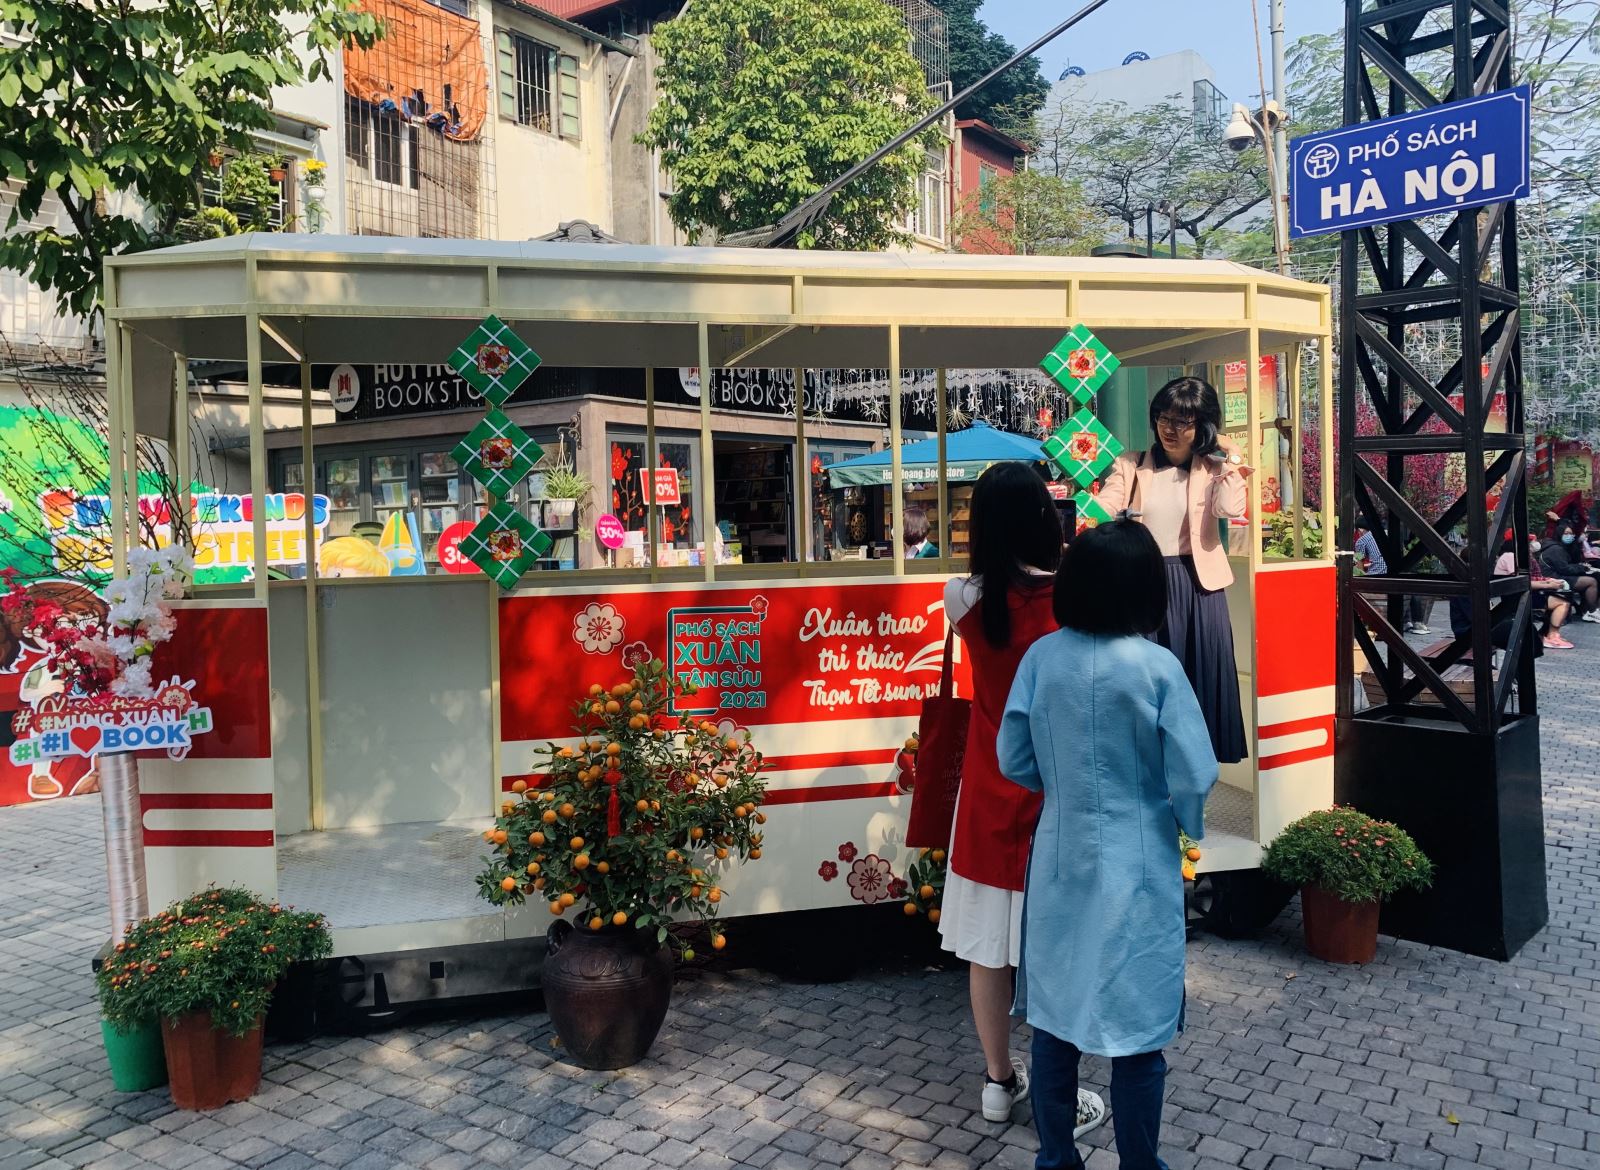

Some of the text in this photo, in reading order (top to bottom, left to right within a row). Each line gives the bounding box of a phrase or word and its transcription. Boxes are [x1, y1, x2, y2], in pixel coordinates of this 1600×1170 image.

[1348, 119, 1477, 165] PHỐ SÁCH
[1320, 150, 1496, 220] HÀ NỘI
[375, 376, 483, 410] BOOKSTO
[882, 469, 893, 480] Hu
[656, 483, 675, 496] 0%
[600, 527, 624, 539] 30%
[444, 546, 469, 565] 30
[675, 618, 761, 637] PHỐ SÁCH
[799, 607, 929, 642] Xuân trao
[675, 634, 761, 666] XUÂN
[677, 666, 762, 688] TÂN SỬU
[720, 691, 767, 708] 2021
[882, 682, 923, 702] sum
[103, 724, 186, 748] BOOK
